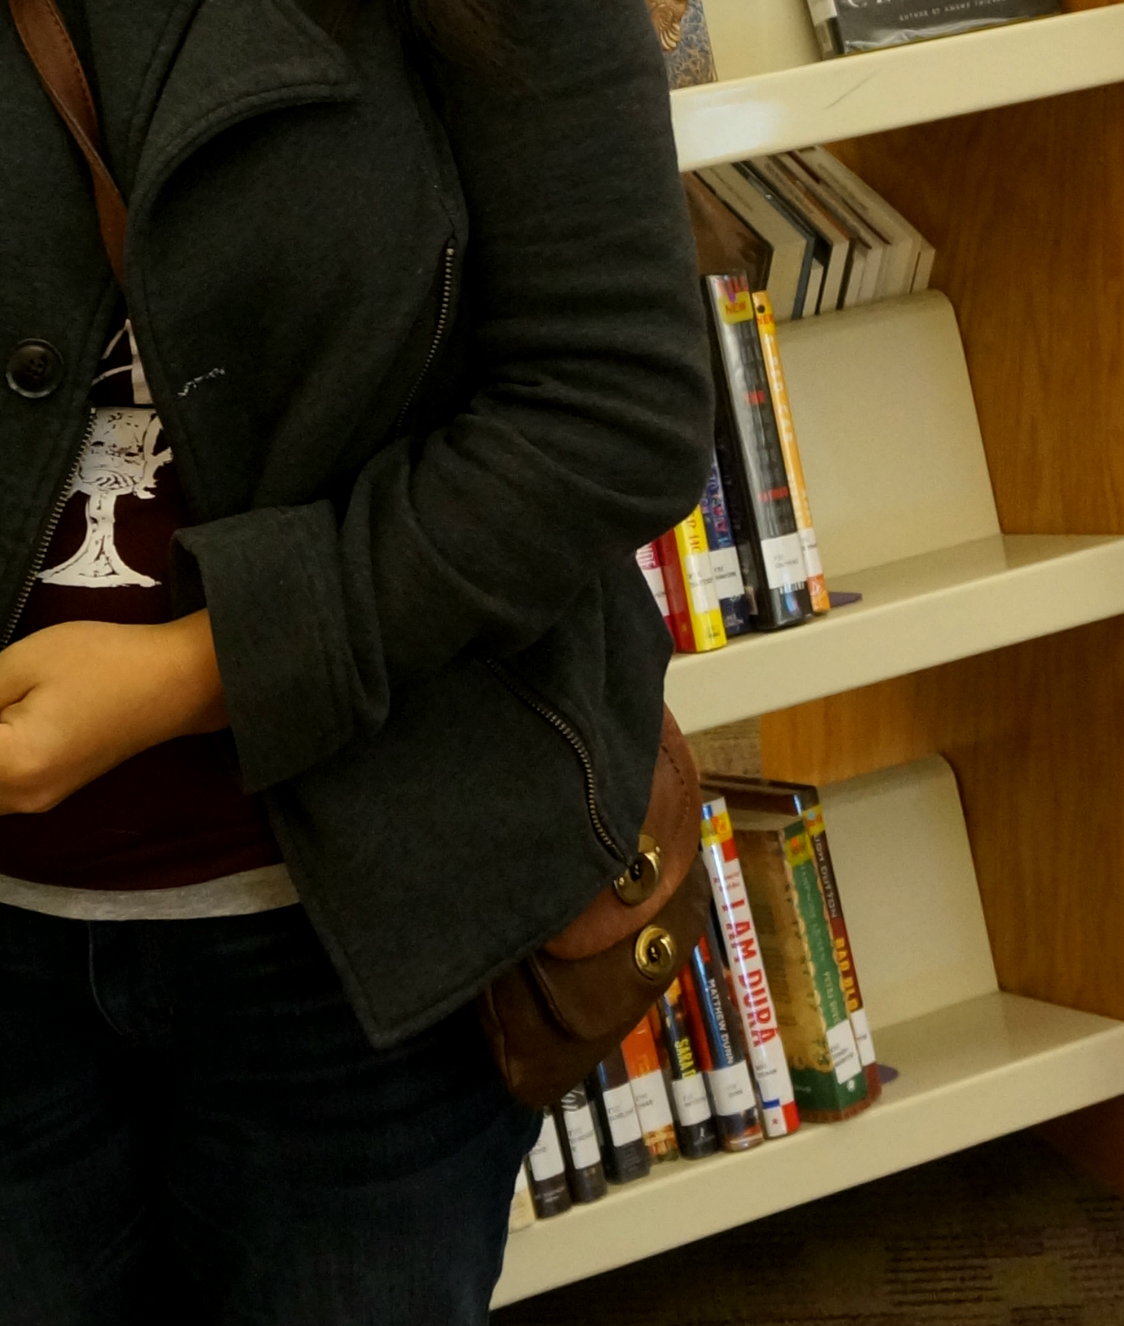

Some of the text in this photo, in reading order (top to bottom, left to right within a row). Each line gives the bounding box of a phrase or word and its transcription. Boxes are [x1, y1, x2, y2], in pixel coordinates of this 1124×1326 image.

[726, 919, 758, 964] AM
[707, 977, 735, 1067] MATTHEW DUNN
[674, 1037, 695, 1070] SARA
